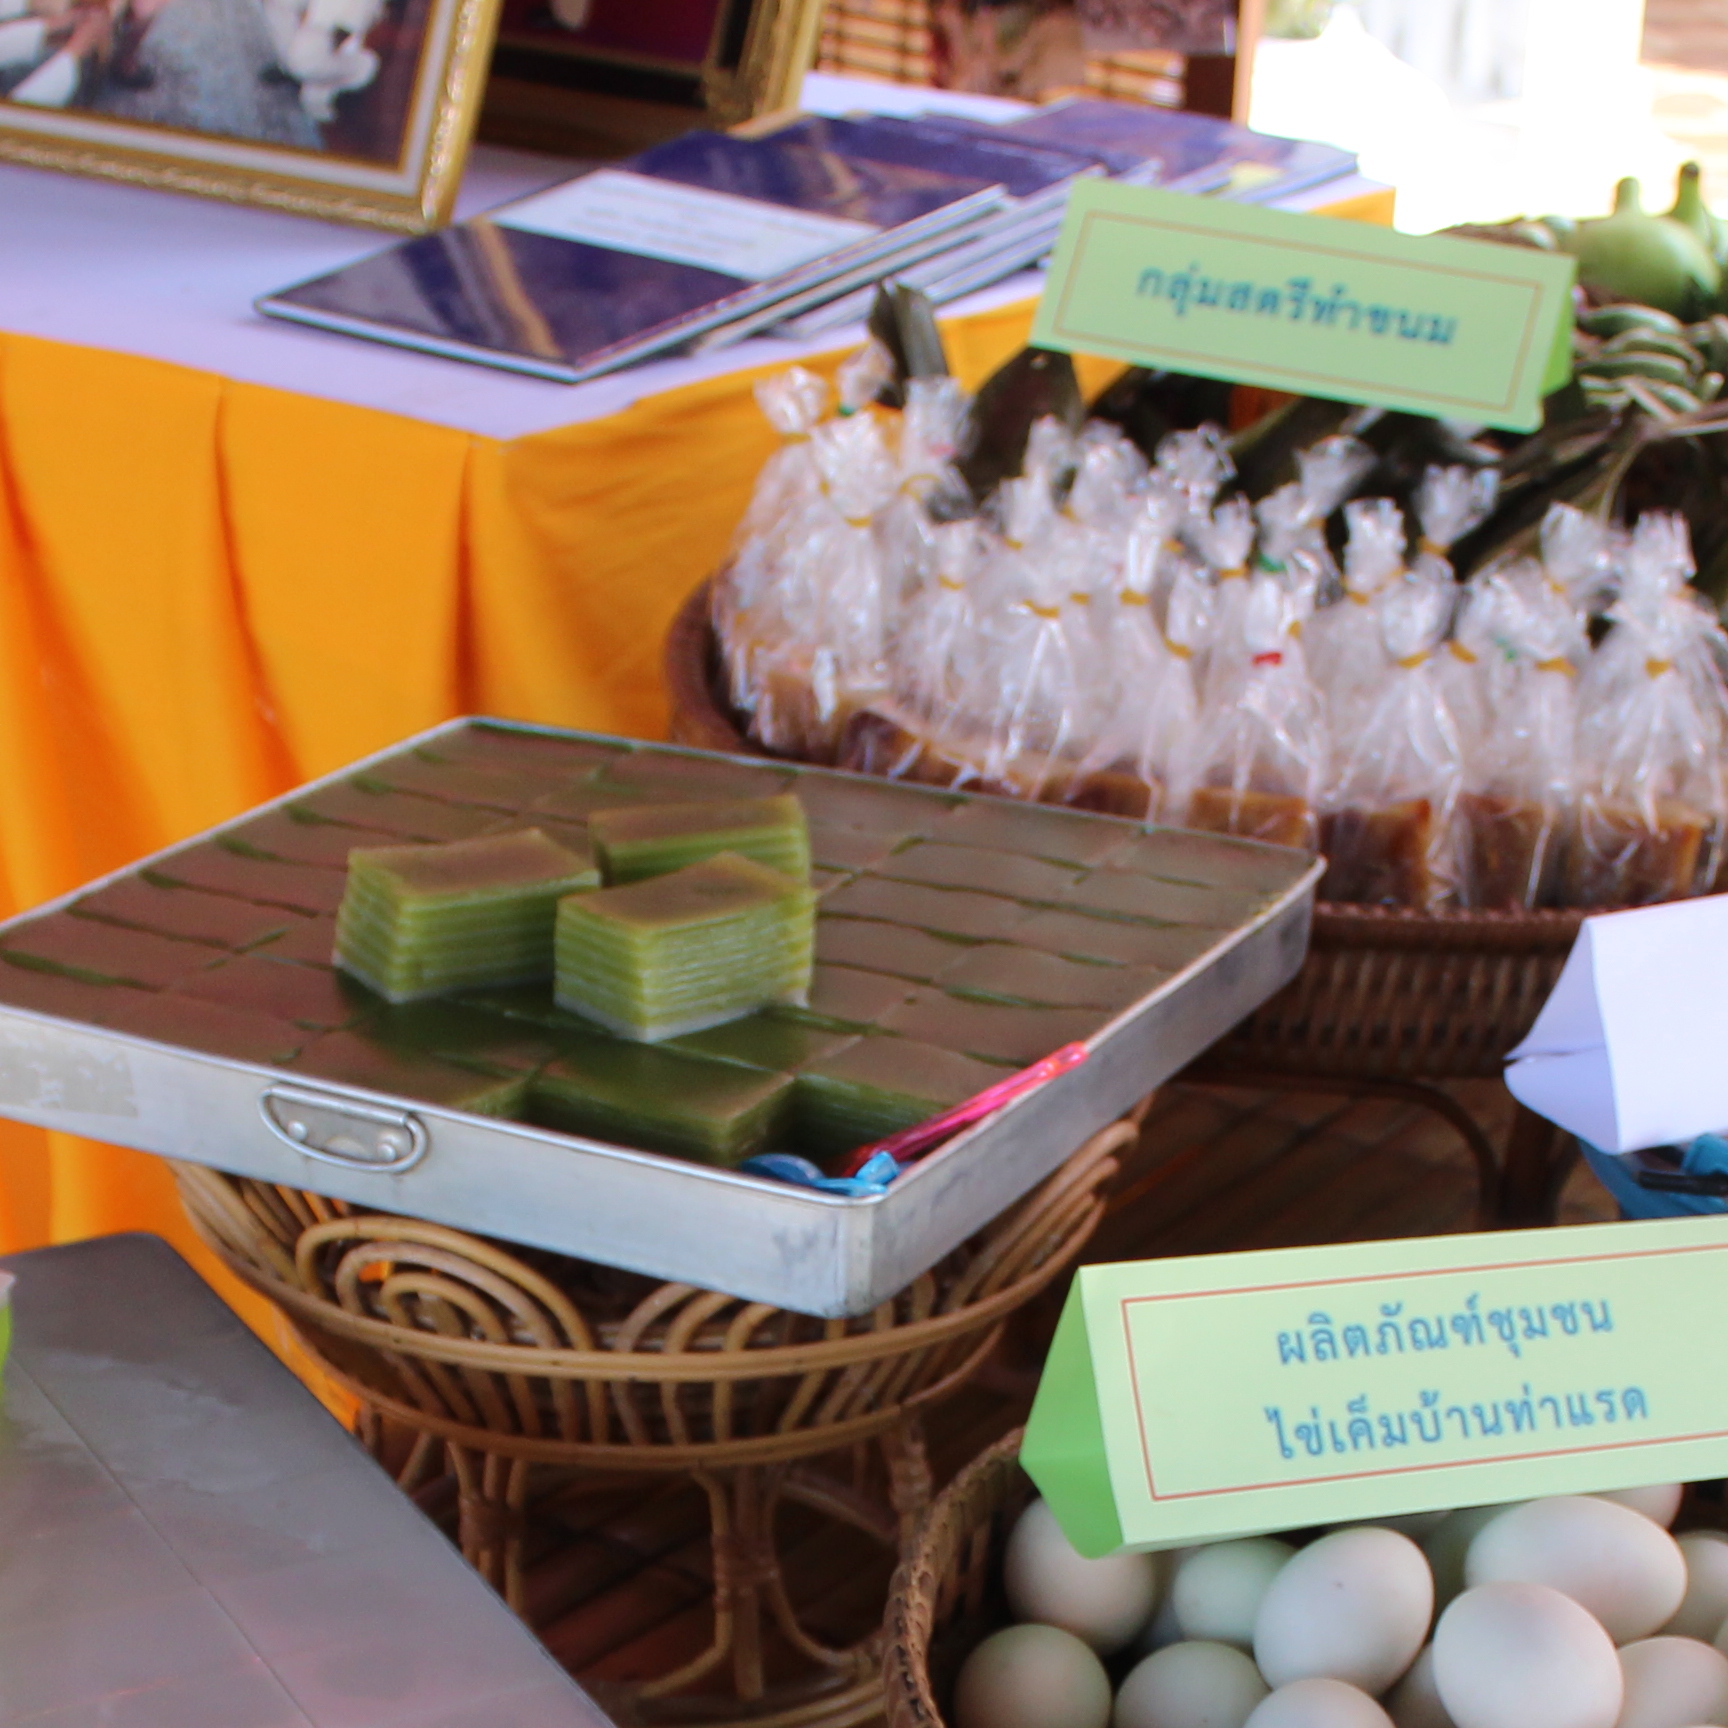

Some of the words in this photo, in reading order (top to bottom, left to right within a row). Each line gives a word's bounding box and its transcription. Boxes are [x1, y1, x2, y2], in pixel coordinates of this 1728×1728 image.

[1137, 262, 1459, 346] กลุ่มสตรีทำขนม
[1276, 1292, 1615, 1366] ผลิตภัณฑ์ชุมชน
[1264, 1382, 1650, 1460] ไข่เค็มบ้านท่าแรด
